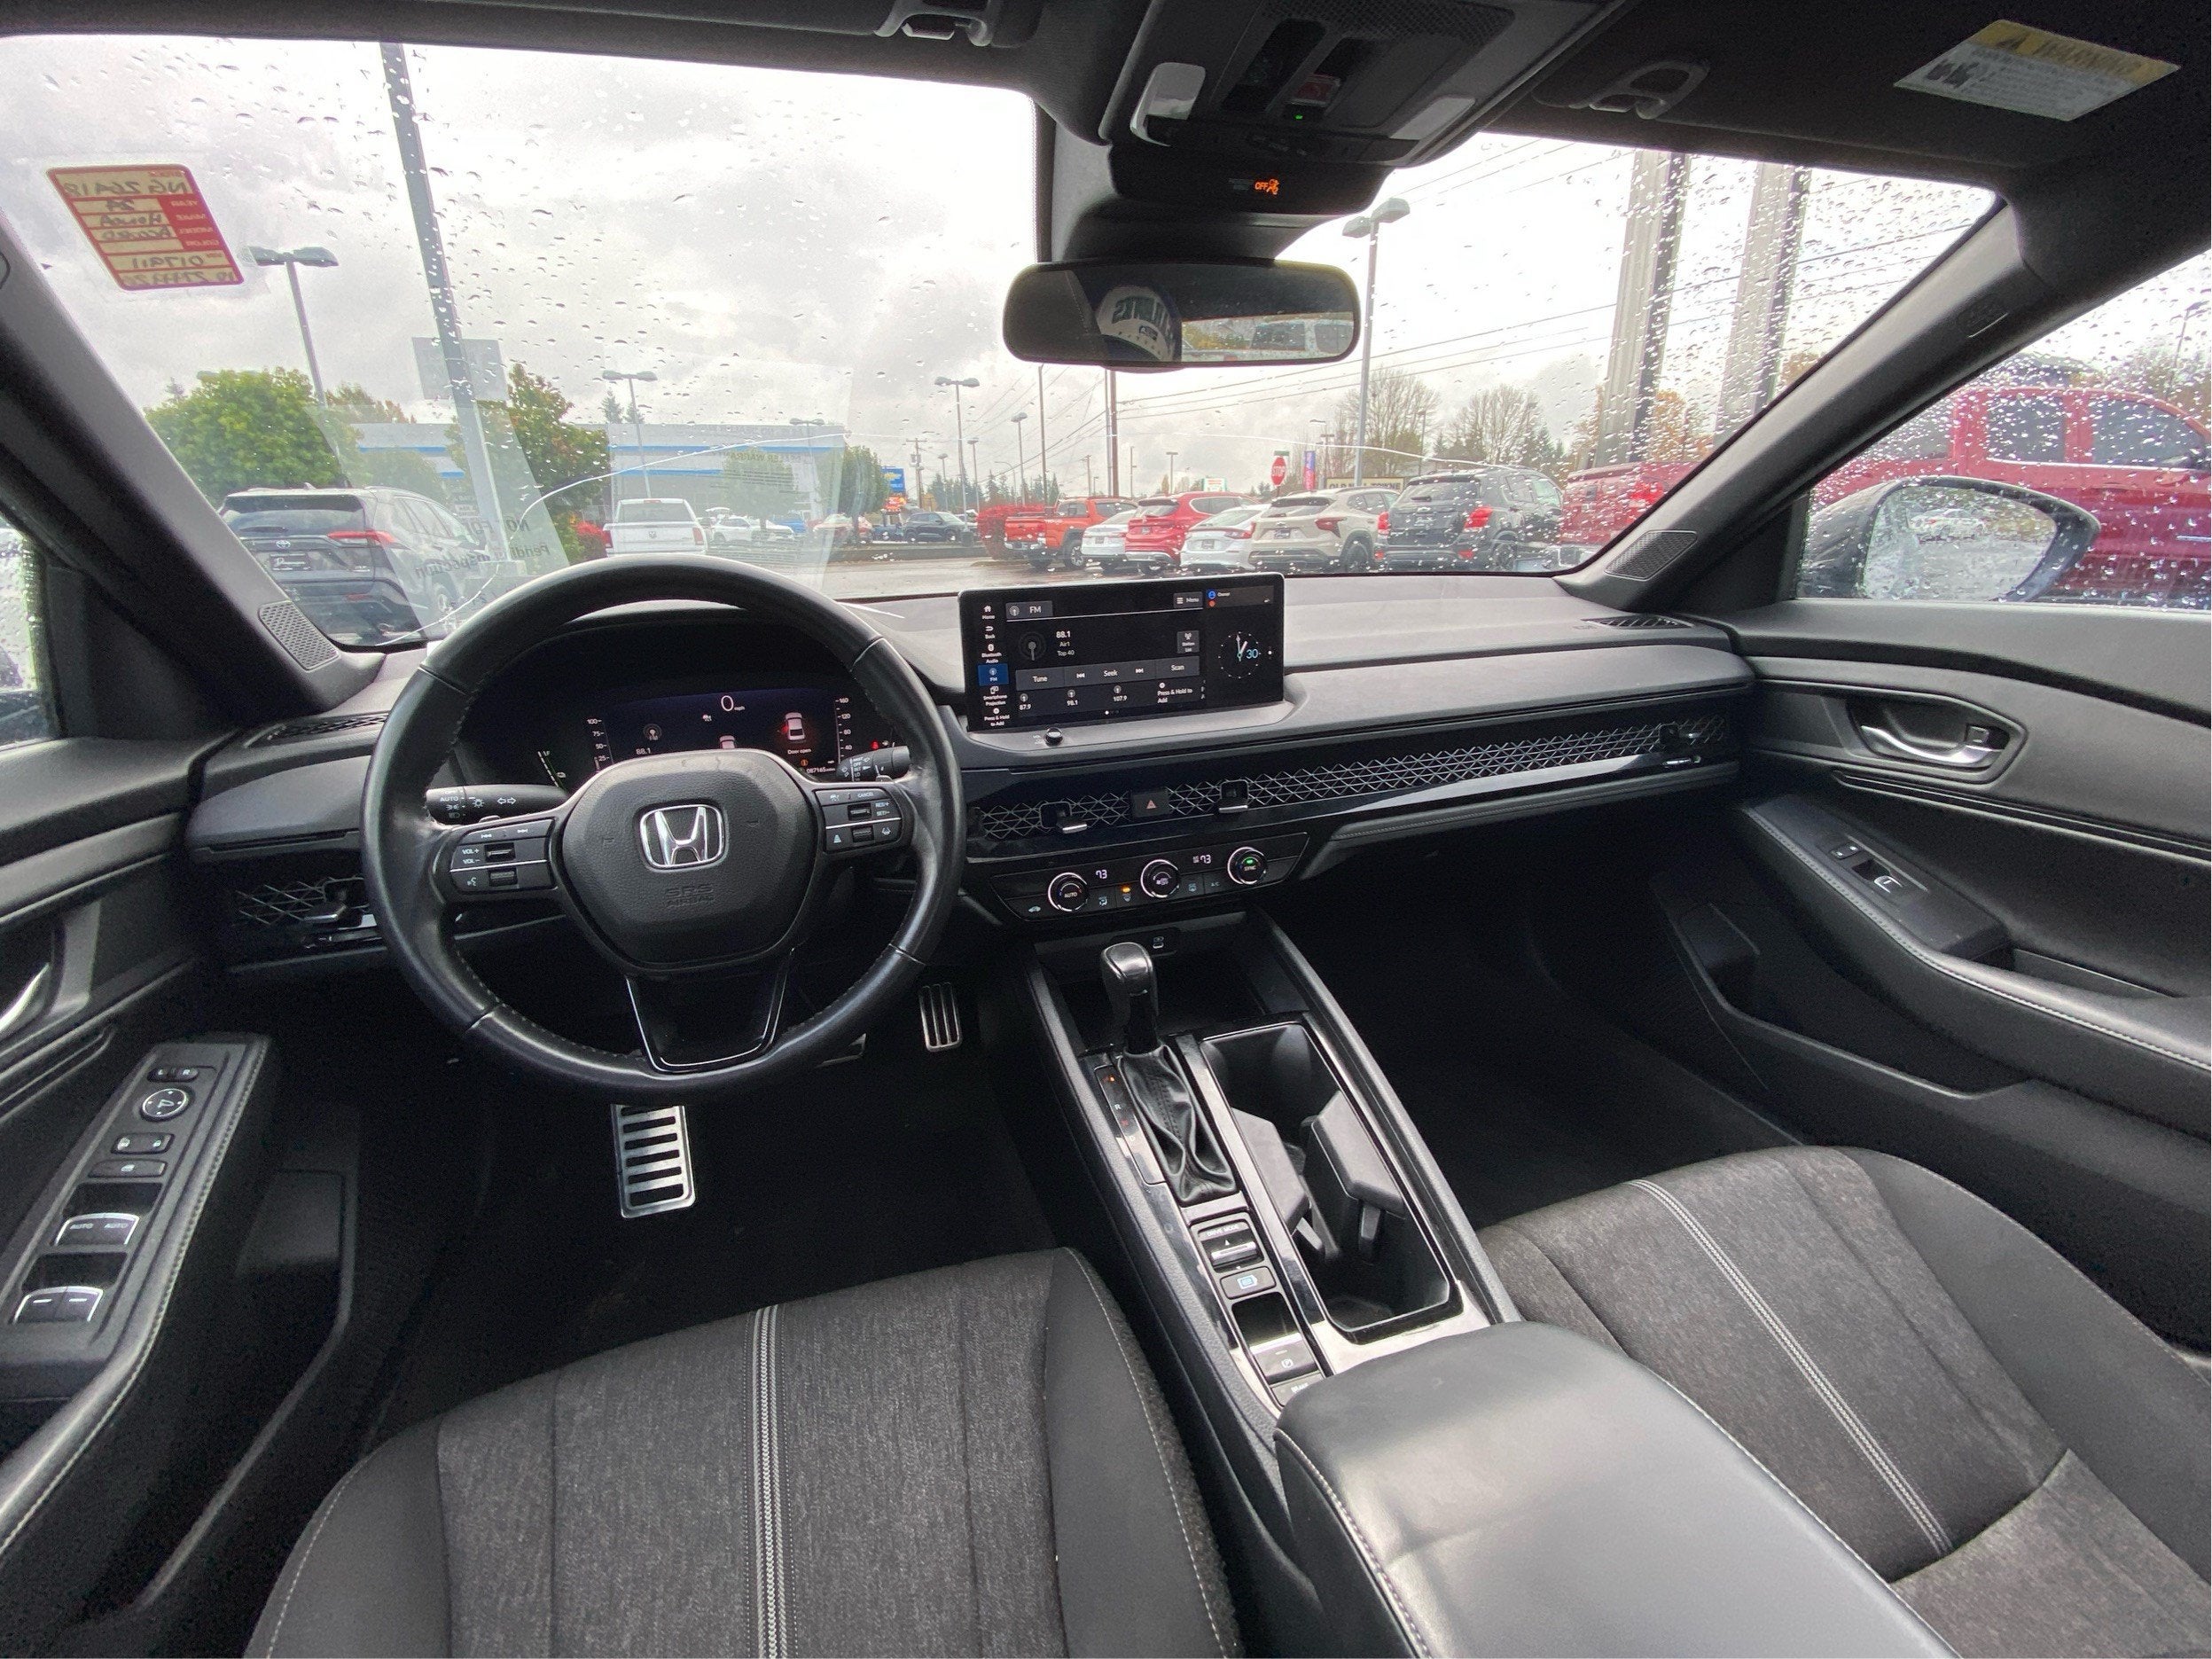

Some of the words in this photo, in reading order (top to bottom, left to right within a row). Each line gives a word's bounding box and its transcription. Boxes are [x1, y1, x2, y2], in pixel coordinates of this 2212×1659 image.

[1272, 466, 1286, 477] STOP
[1246, 648, 1259, 660] 30
[1032, 675, 1049, 684] Tune
[720, 695, 734, 712] 0
[1200, 854, 1212, 864] 73
[1095, 869, 1108, 879] 73
[1207, 1227, 1223, 1237] DRIVE
[1223, 1223, 1240, 1233] MODE
